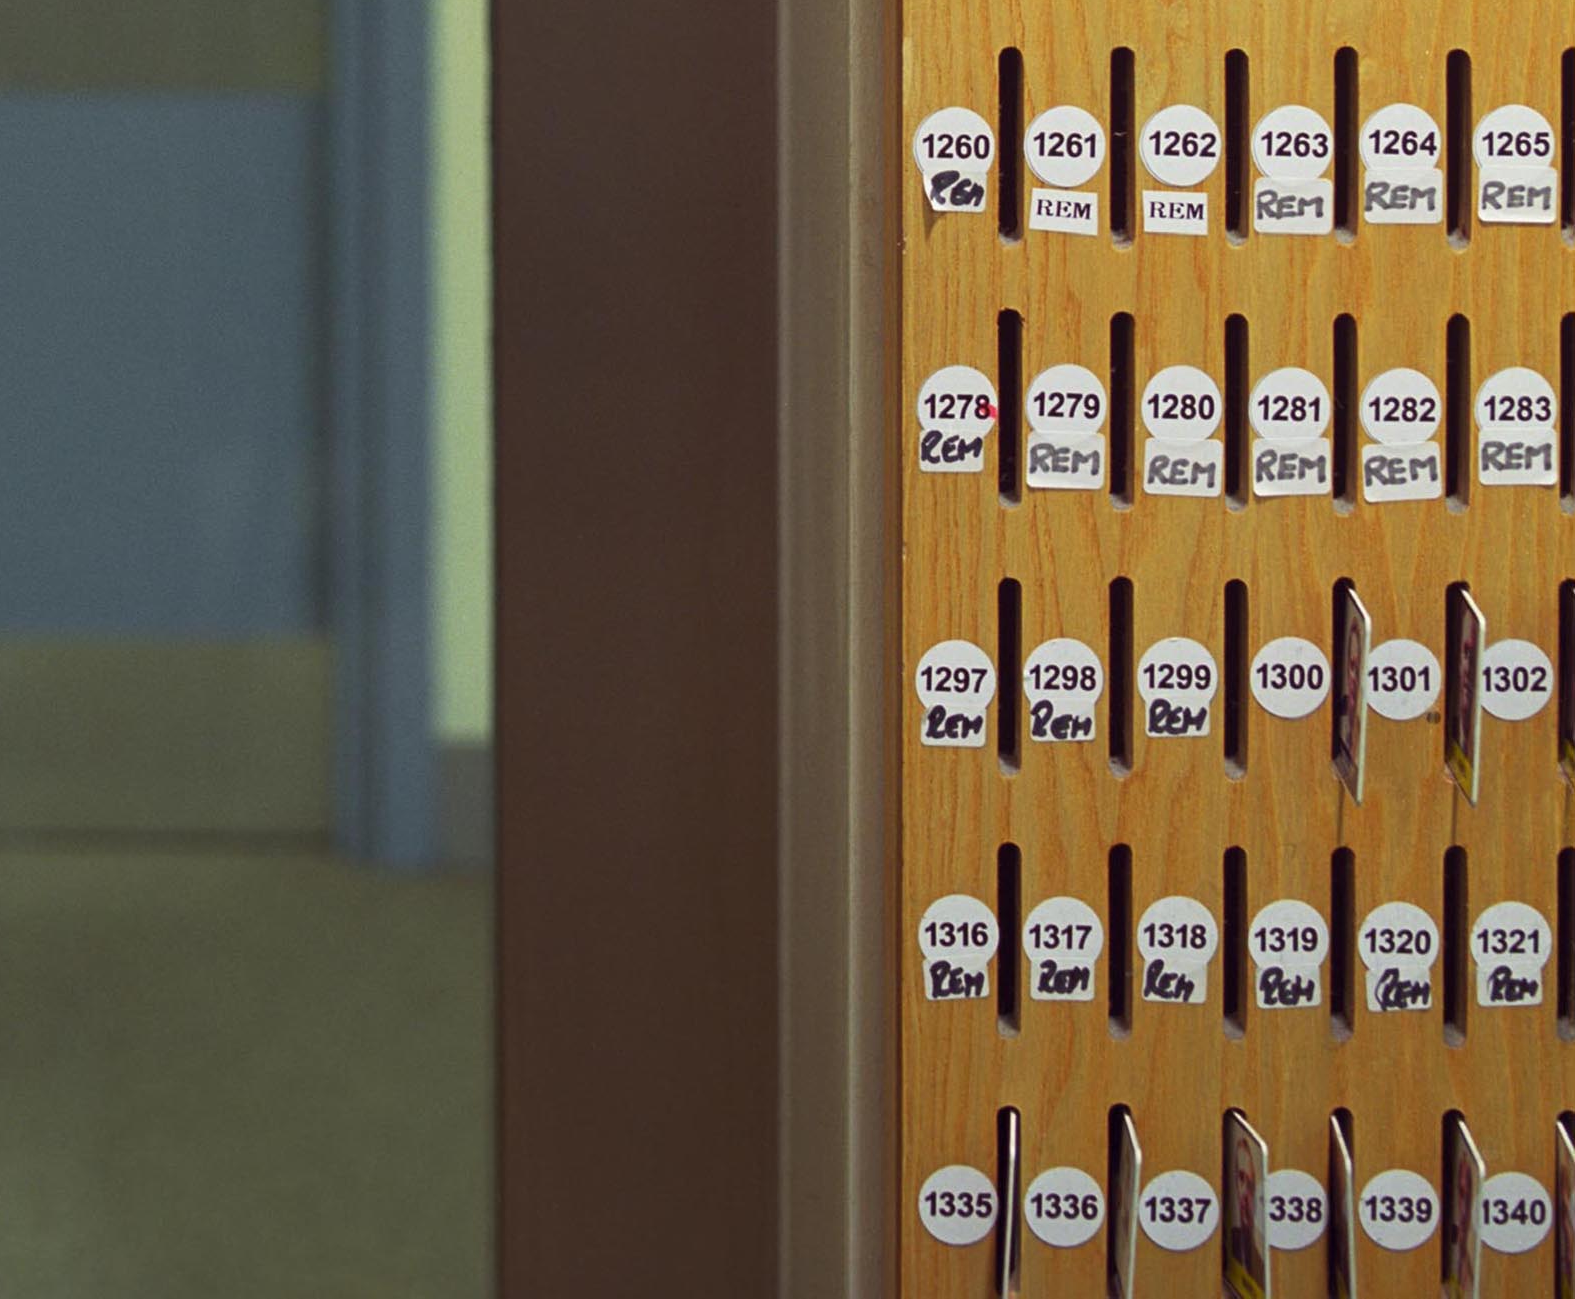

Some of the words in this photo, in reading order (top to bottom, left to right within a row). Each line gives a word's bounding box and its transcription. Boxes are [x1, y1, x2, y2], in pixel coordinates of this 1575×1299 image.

[922, 133, 990, 160] 1260
[1033, 131, 1096, 158] 1261
[1149, 130, 1217, 158] 1262
[1261, 131, 1329, 158] 1263
[1368, 129, 1438, 156] 1264
[1482, 131, 1550, 157] 1265
[1036, 199, 1092, 220] REM
[1150, 200, 1205, 220] REM
[1256, 192, 1325, 221] REM
[1364, 182, 1437, 214] REM
[1481, 181, 1554, 211] REM
[924, 393, 993, 420] 1278
[1033, 391, 1100, 420] 1279
[1147, 393, 1215, 421] 1280
[1257, 395, 1321, 422] 1281
[1368, 396, 1436, 423] 1282
[1484, 395, 1552, 422] 1283
[921, 430, 985, 464] REM
[1029, 442, 1101, 477] REM
[1481, 441, 1554, 474] REM
[1147, 456, 1218, 488] REM
[1254, 448, 1328, 485] REM
[1363, 455, 1438, 485] REM
[920, 665, 988, 694] 1297
[1029, 664, 1097, 692] 1298
[1143, 663, 1211, 691] 1299
[1256, 663, 1324, 691] 1300
[1367, 665, 1430, 692] 1301
[1482, 666, 1547, 693] 1302
[925, 704, 985, 741] REM
[1030, 701, 1093, 738] REM
[1147, 699, 1208, 736] REM
[924, 921, 989, 947] 1316
[1029, 923, 1093, 950] 1317
[1143, 923, 1207, 950] 1318
[1254, 926, 1319, 953] 1319
[1364, 928, 1431, 955] 1320
[1477, 928, 1540, 955] 1321
[928, 960, 987, 999] REM
[1037, 960, 1092, 996] REM
[1144, 959, 1195, 1003] REM
[924, 1191, 993, 1219] 1335
[1030, 1192, 1099, 1221] 1336
[1145, 1196, 1212, 1224] 1337
[1268, 1196, 1323, 1224] 338
[1365, 1195, 1433, 1224] 1339
[1482, 1199, 1547, 1226] 1340
